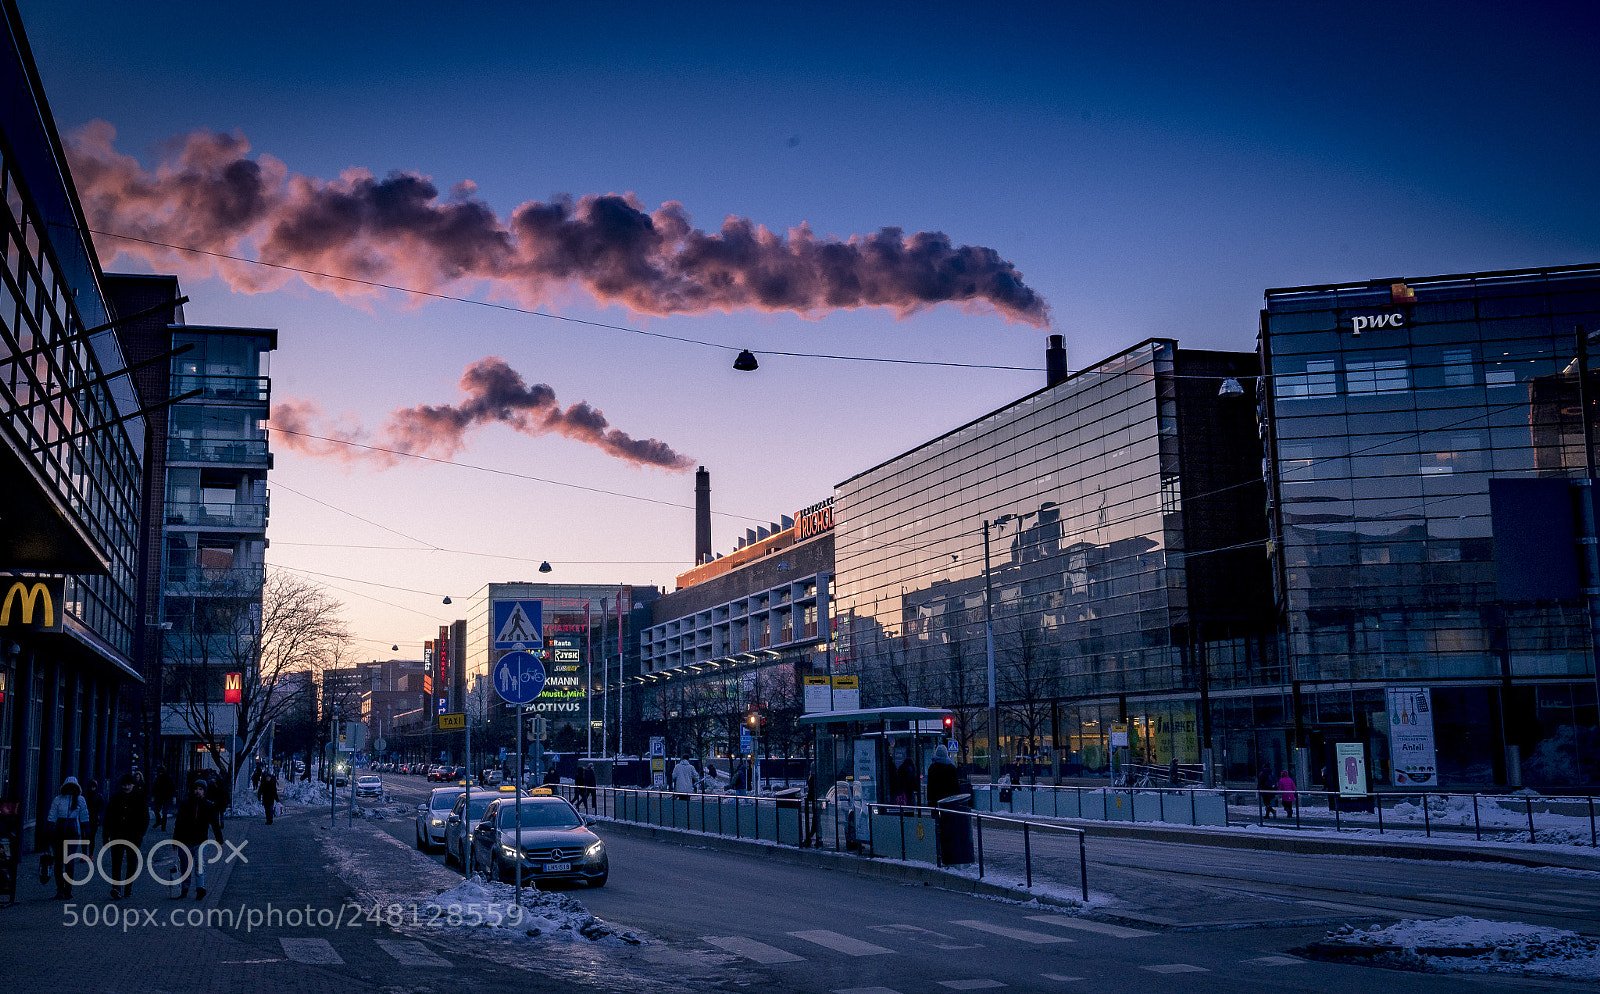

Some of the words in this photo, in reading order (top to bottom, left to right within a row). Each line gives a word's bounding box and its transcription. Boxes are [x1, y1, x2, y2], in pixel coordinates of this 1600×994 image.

[1351, 313, 1404, 335] pwc
[560, 651, 578, 659] JYSK
[554, 664, 581, 672] SUBWAY
[226, 674, 240, 690] M
[439, 698, 446, 706] P
[525, 702, 580, 712] MOTIVUS
[444, 716, 461, 726] TAXI
